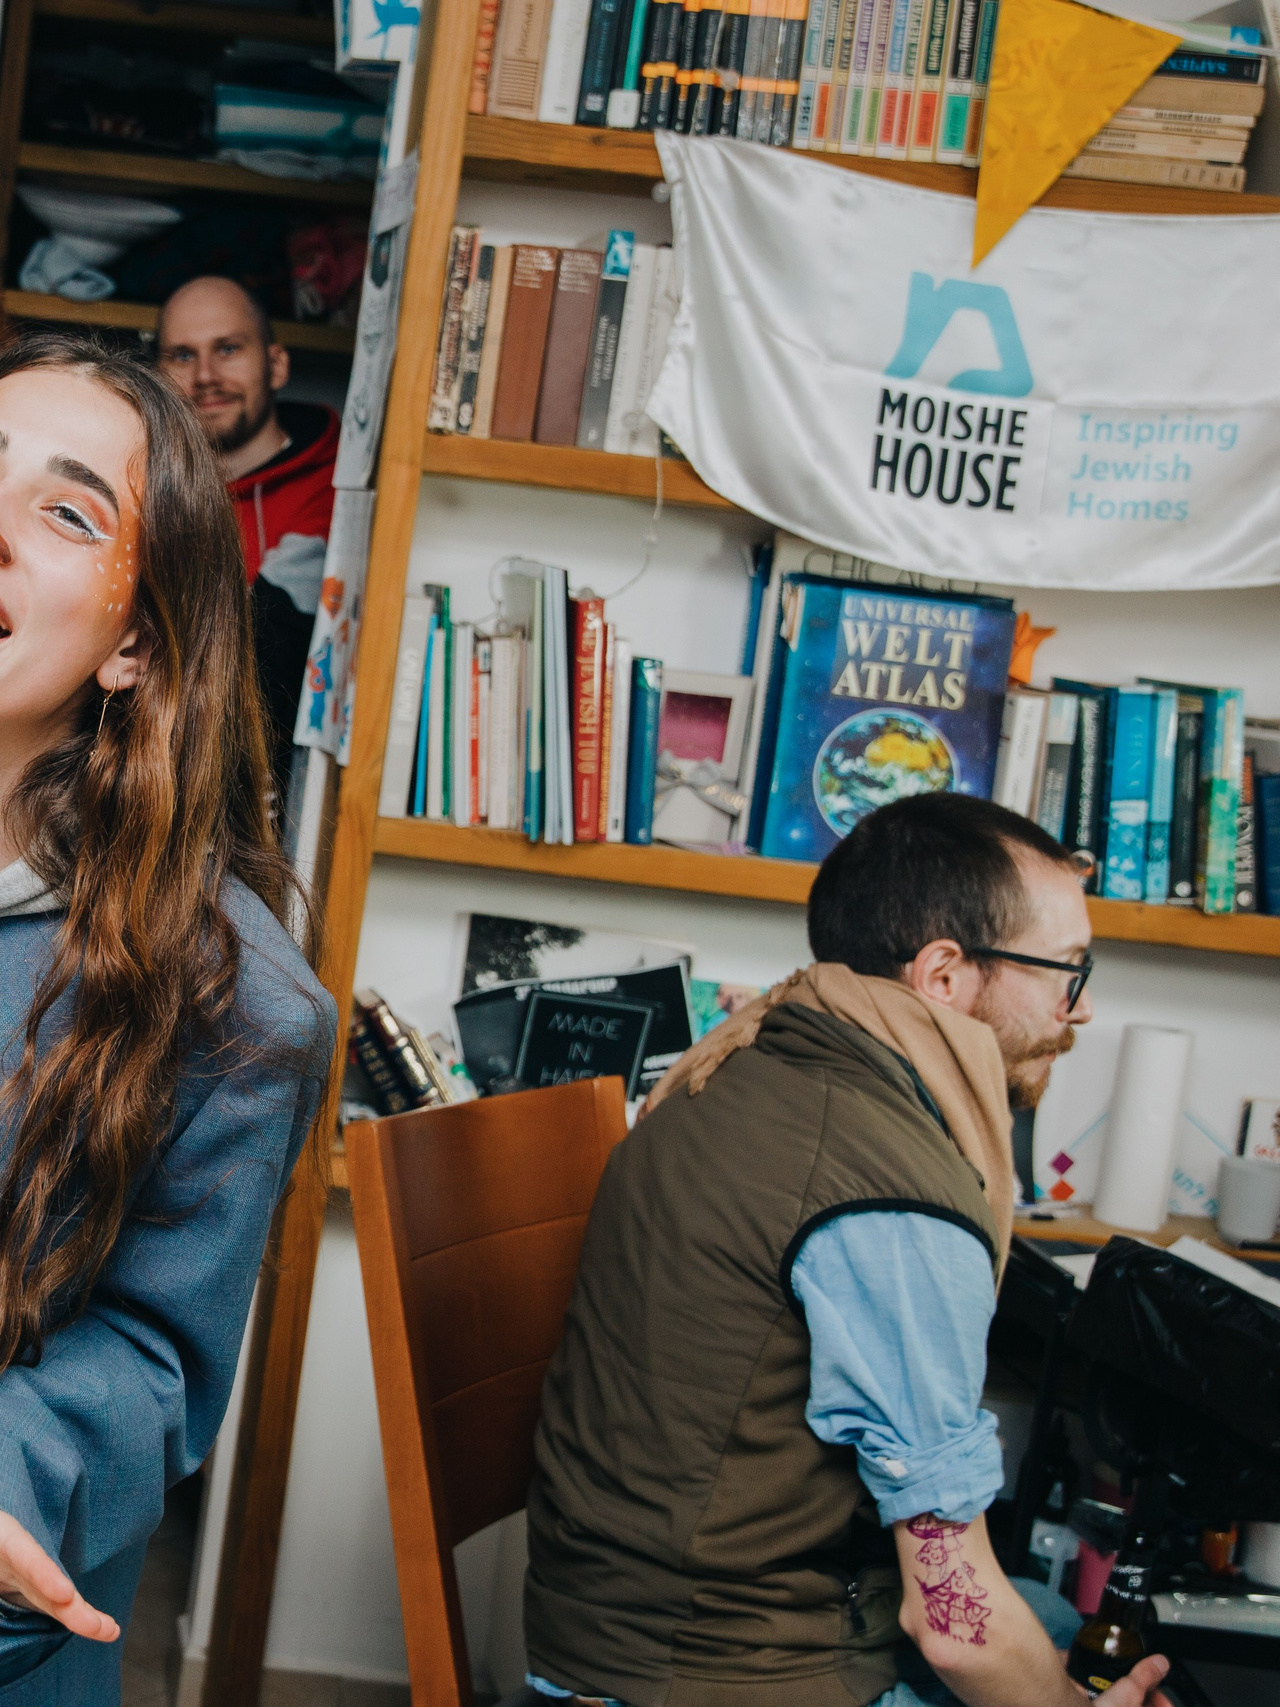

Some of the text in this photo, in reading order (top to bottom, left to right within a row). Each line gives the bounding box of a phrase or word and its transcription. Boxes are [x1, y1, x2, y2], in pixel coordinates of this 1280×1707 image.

[1162, 56, 1228, 74] SAPIEN
[797, 94, 812, 132] 1984
[876, 388, 1028, 448] MOISHE
[1076, 413, 1239, 451] Inspiring
[870, 434, 1021, 513] HOUSE
[1070, 453, 1192, 482] Jewish
[1067, 491, 1189, 523] Homes
[844, 596, 974, 632] UNIVERSAL
[841, 619, 973, 671] WELT
[573, 655, 599, 733] JEWISH
[831, 660, 968, 711] ATLAS
[577, 740, 597, 773] 100
[547, 1010, 626, 1041] MADE
[567, 1041, 595, 1064] IN
